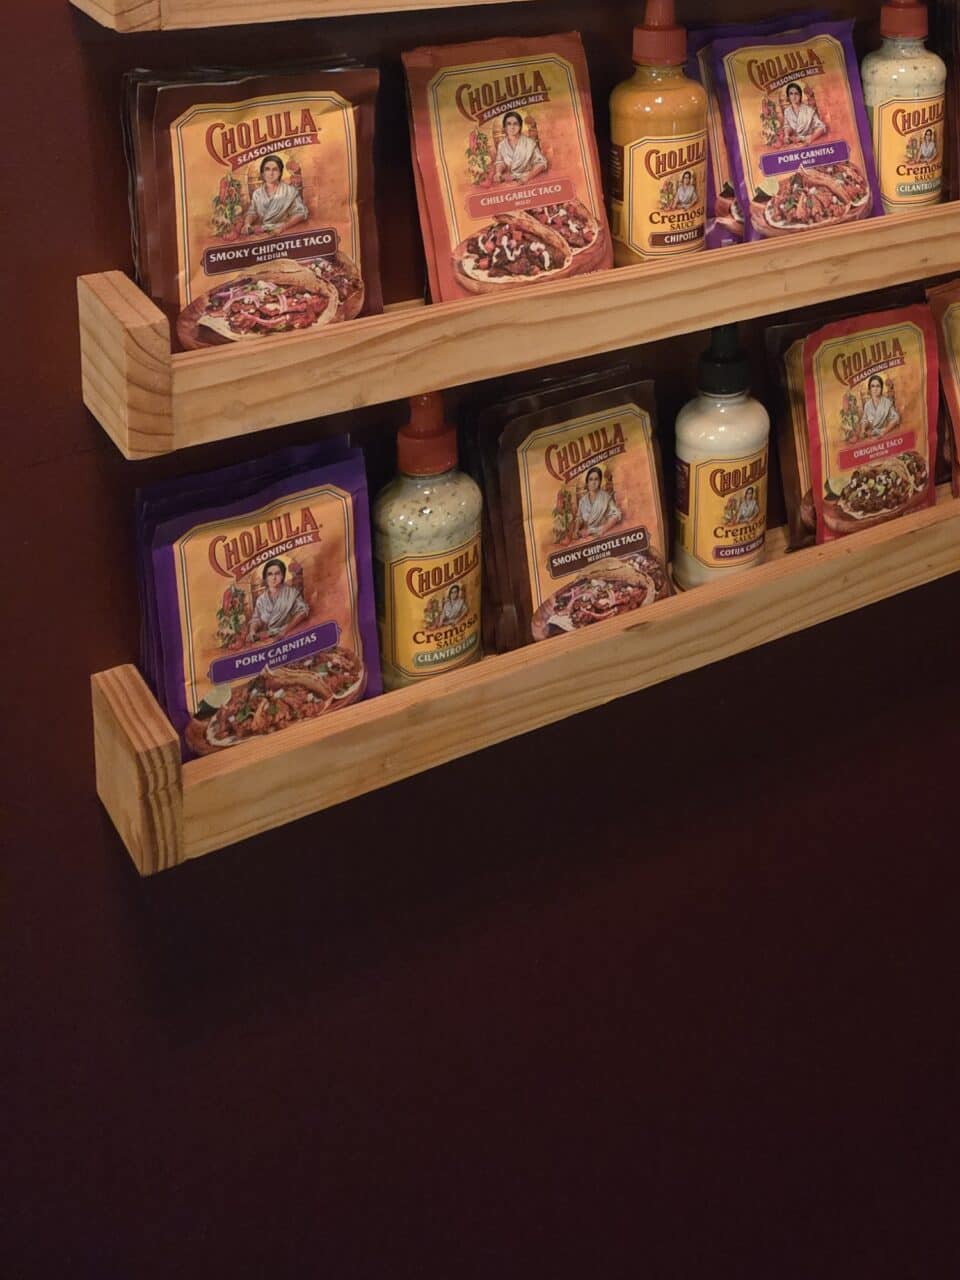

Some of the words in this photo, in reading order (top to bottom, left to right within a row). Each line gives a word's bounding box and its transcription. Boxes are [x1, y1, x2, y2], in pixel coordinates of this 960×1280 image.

[747, 48, 822, 92] CHOLULA
[455, 70, 547, 122] CHOLULA
[483, 98, 527, 120] SEASONING
[528, 95, 544, 104] MIX
[206, 108, 318, 167] CHOLULA
[236, 138, 292, 165] SEASONING
[293, 136, 313, 145] MIX
[778, 153, 801, 164] PORK
[801, 147, 835, 160] CARNITAS
[480, 196, 505, 207] CHILI
[505, 189, 538, 202] GARLIC
[538, 184, 562, 196] TACO
[210, 248, 250, 263] SMOKY
[251, 239, 302, 256] CHIPOTLE
[303, 234, 332, 247] TACO
[256, 251, 288, 262] MEDIUM
[832, 337, 903, 385] CHOLULA
[853, 362, 888, 383] SEASONING
[545, 423, 626, 481] CHOLULA
[569, 453, 608, 476] SEASONING
[609, 446, 621, 458] MIX
[853, 443, 884, 458] ORIGINAL
[885, 437, 903, 449] TACO
[208, 507, 317, 577] CHOLULA
[240, 539, 293, 574] SEASONING
[294, 533, 313, 547] MIX
[552, 551, 581, 567] SMOKY
[583, 538, 620, 557] CHIPOTLE
[621, 531, 644, 545] TACO
[235, 652, 266, 669] PORK
[268, 633, 317, 658] CARNITAS
[268, 654, 288, 666] MILD
[417, 643, 462, 664] CILANTRO
